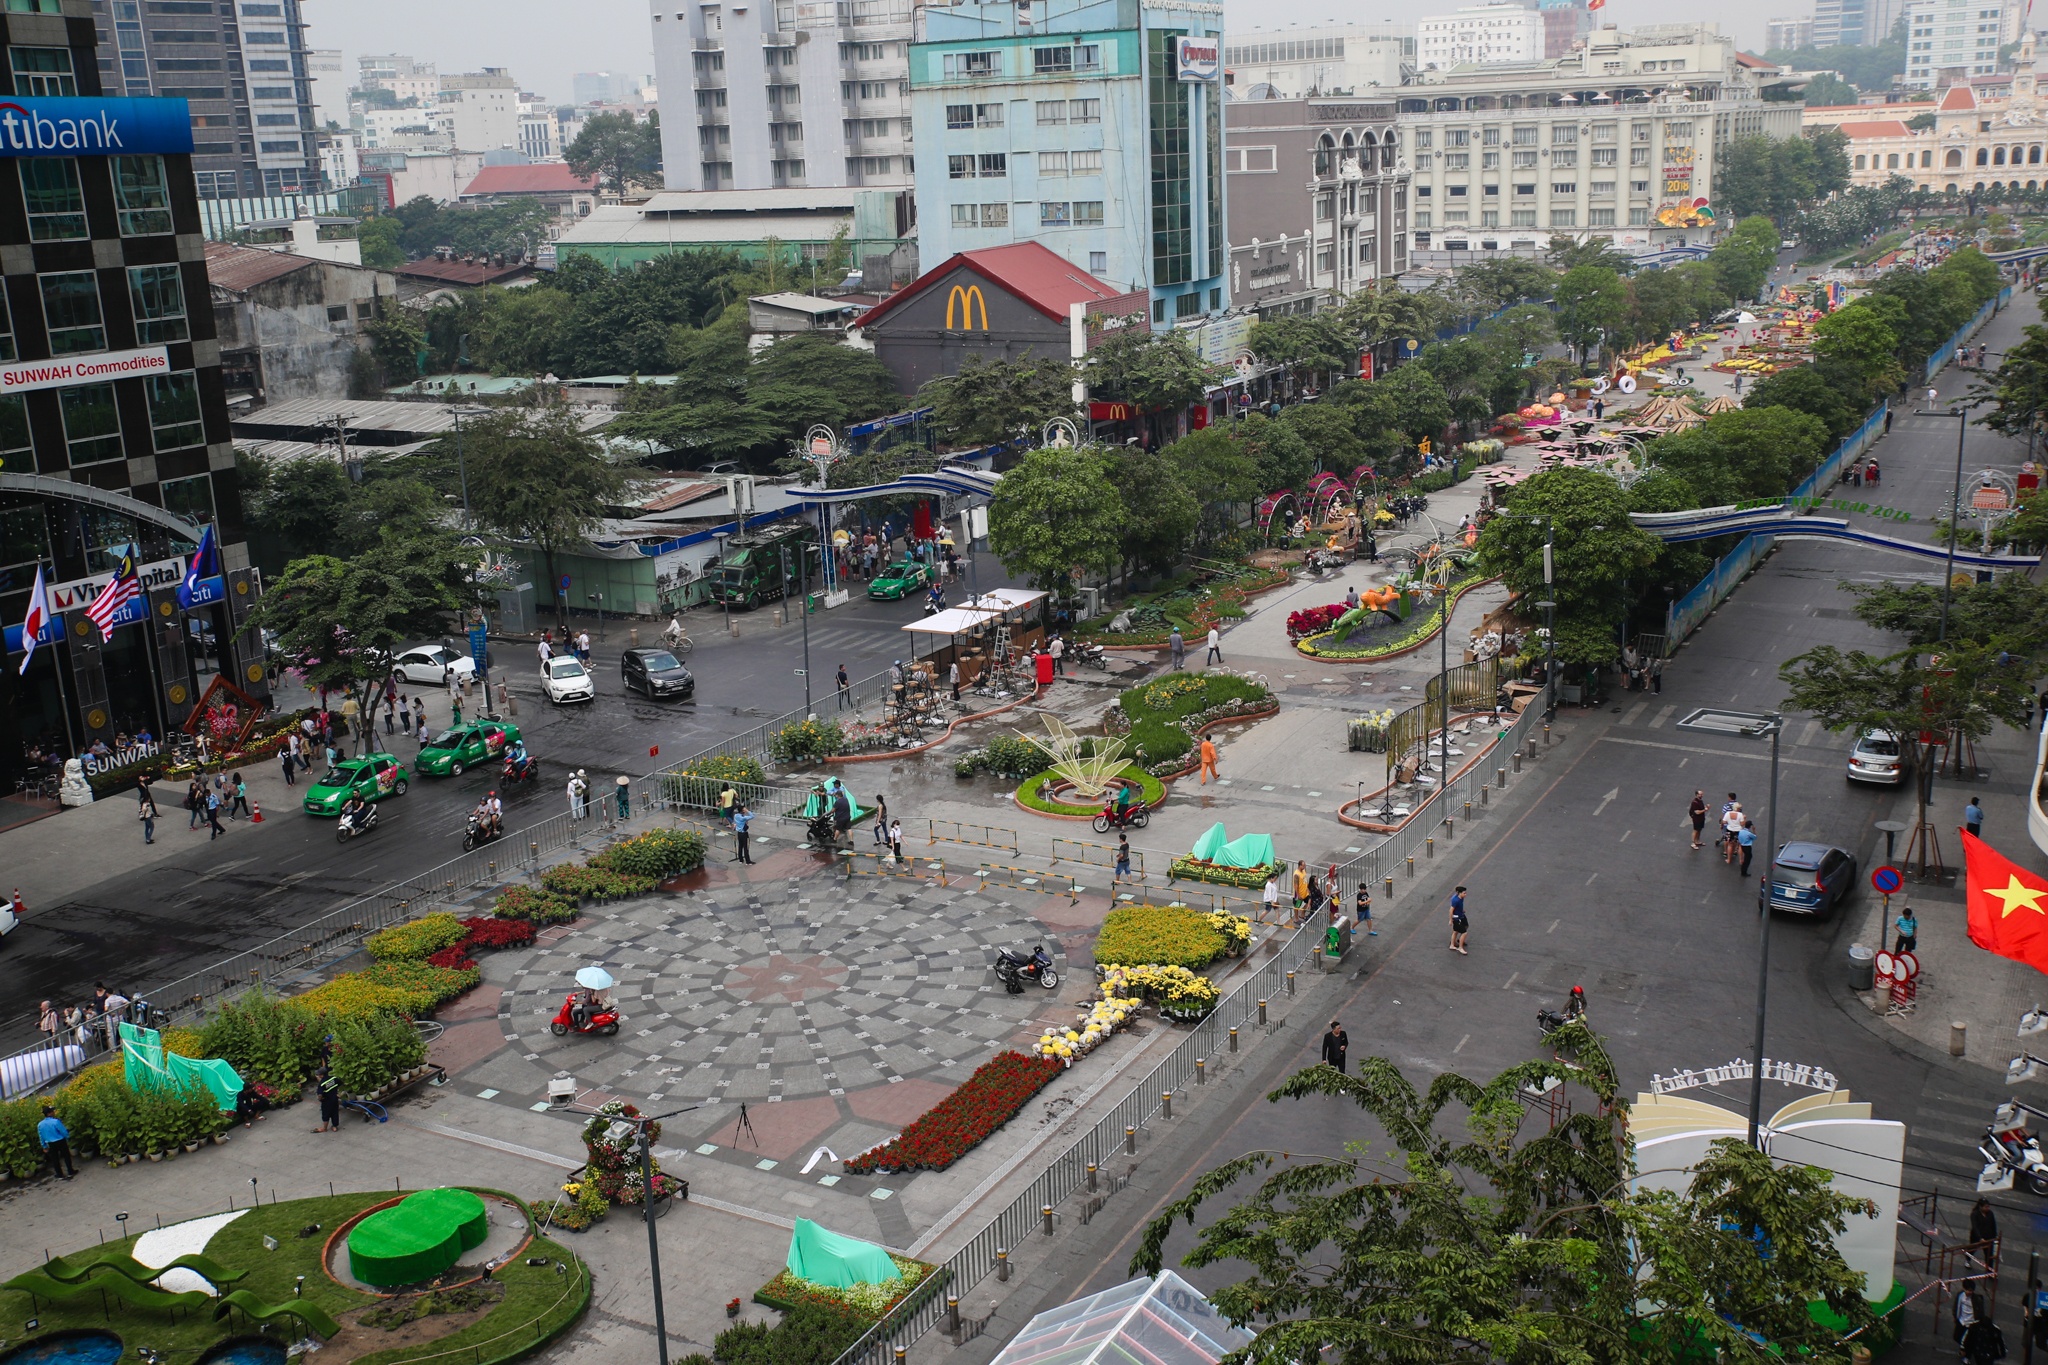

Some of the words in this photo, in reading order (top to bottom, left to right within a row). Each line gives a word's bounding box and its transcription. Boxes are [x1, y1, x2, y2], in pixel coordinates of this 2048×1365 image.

[1676, 103, 1710, 113] HOTEL
[1667, 180, 1689, 192] 2018
[3, 365, 72, 386] SUNWAH
[76, 355, 165, 376] Commodities
[1832, 499, 1869, 513] YEAR
[1872, 505, 1911, 522] 2018
[191, 586, 211, 603] citi
[87, 742, 159, 776] SUNWAH
